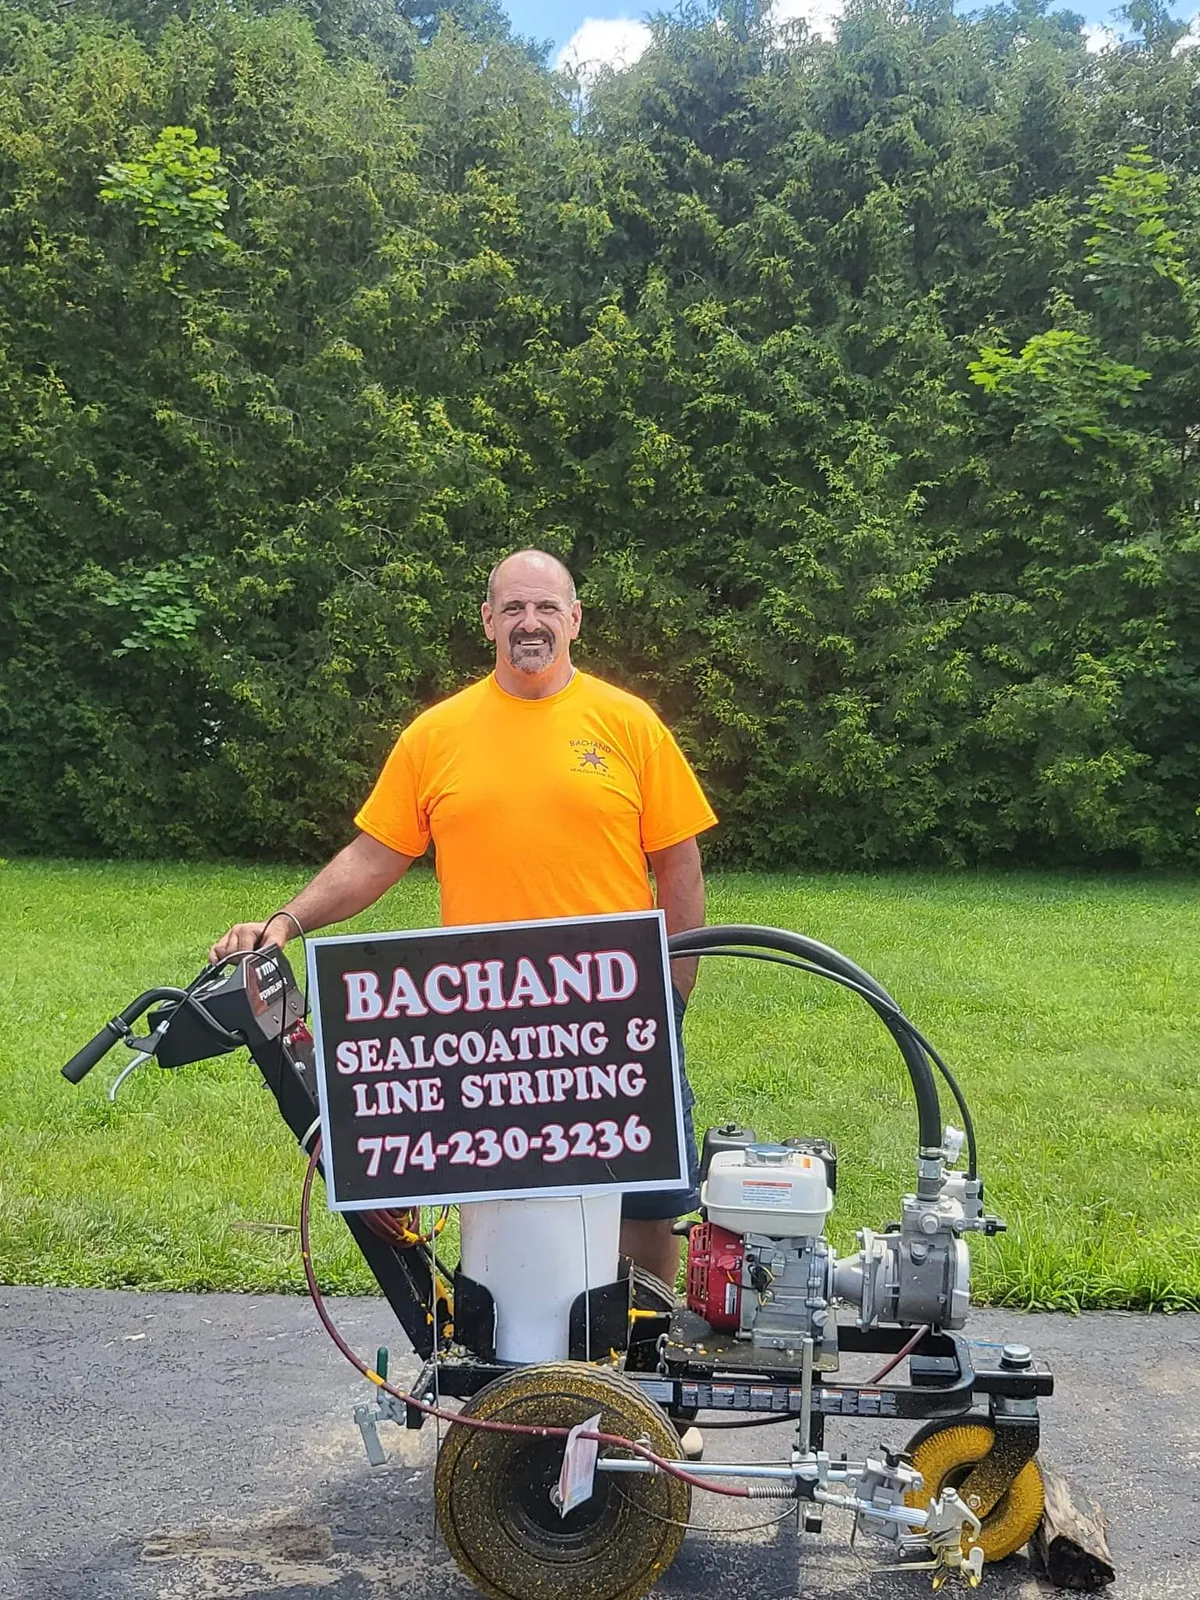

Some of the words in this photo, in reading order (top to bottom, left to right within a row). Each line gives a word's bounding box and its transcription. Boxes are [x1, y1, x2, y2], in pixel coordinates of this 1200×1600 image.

[569, 740, 612, 753] BACHAND
[342, 949, 638, 1021] BACHAND
[336, 1020, 609, 1074] SEALCOATING
[625, 1017, 657, 1052] &
[352, 1077, 445, 1117] LINE
[460, 1062, 647, 1109] STRIPING
[357, 1114, 651, 1177] 774-230-3236
